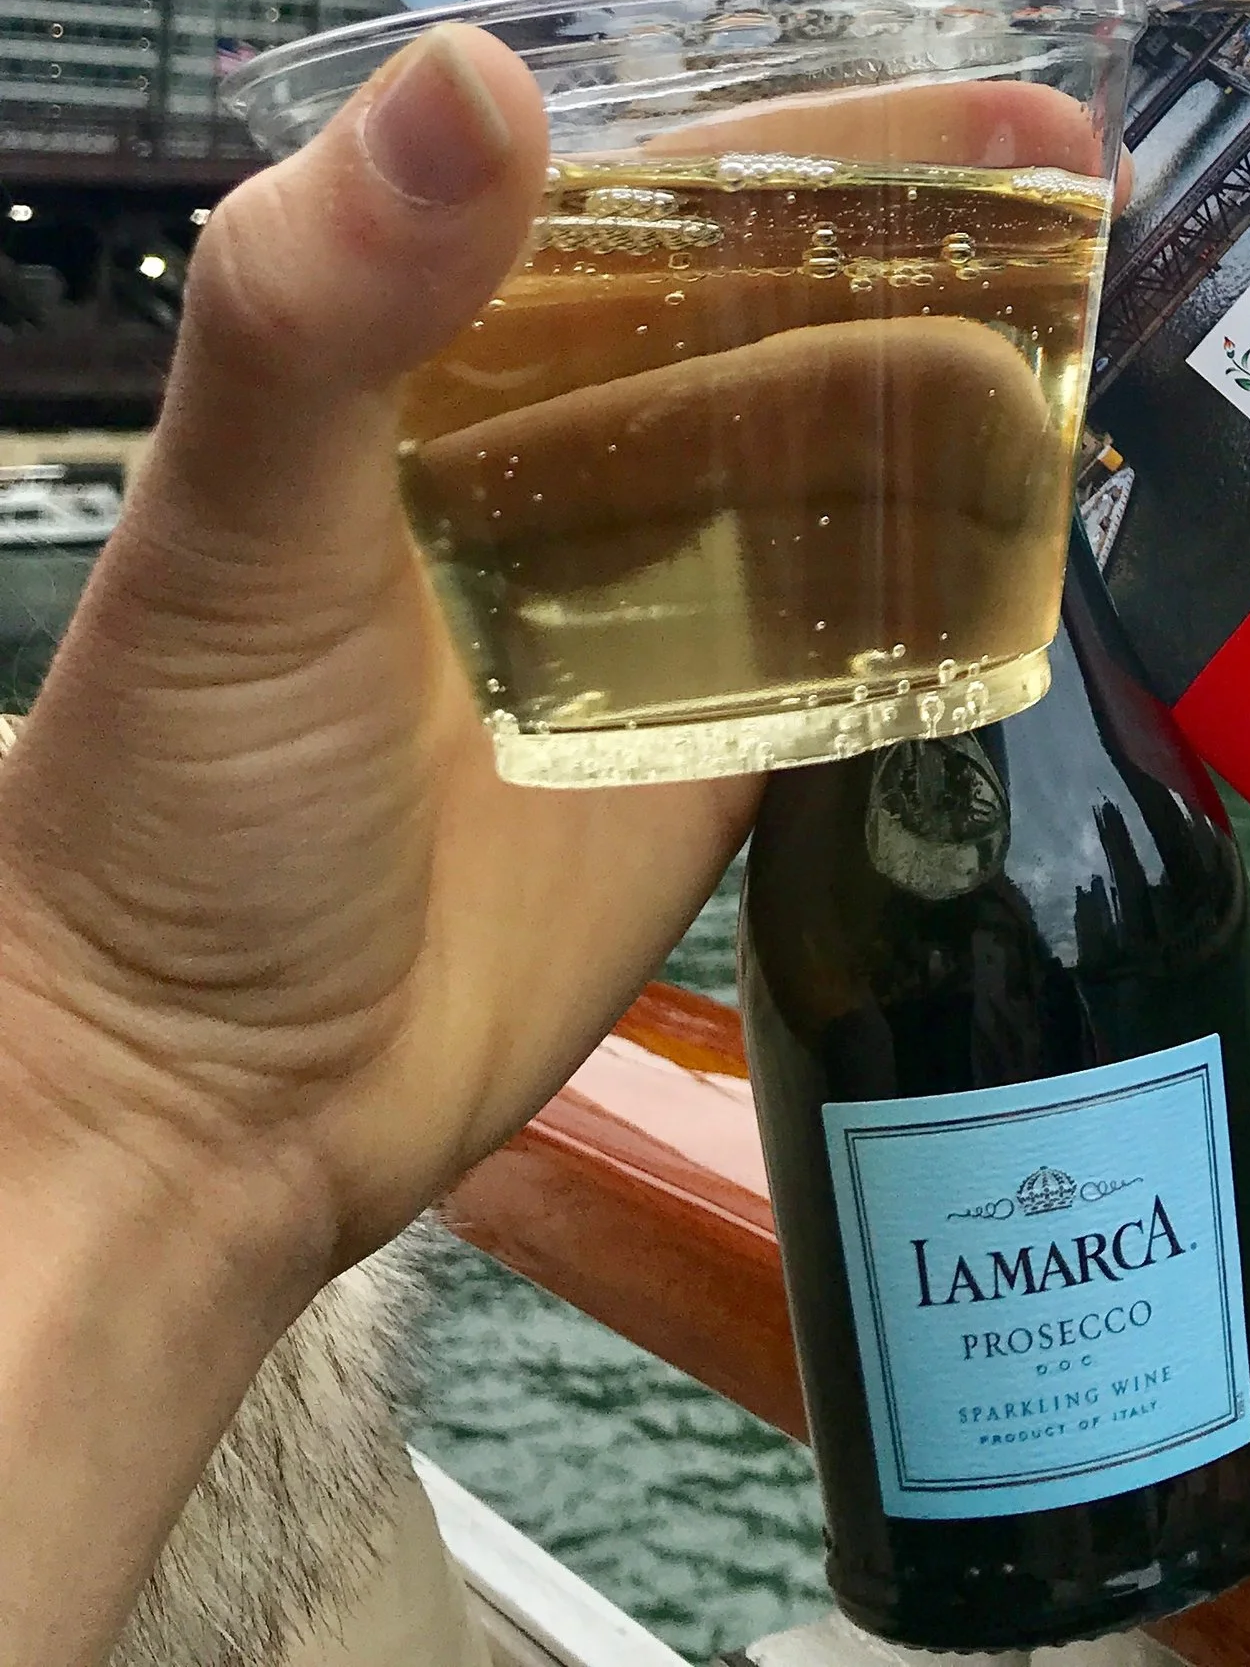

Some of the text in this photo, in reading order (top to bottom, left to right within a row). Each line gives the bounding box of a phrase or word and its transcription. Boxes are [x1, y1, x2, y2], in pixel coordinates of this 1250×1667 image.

[962, 1300, 1152, 1360] PROSECCO
[958, 1365, 1172, 1425] SPARKLING WINE
[979, 1400, 1158, 1446] PRODUCT OF ITALY
